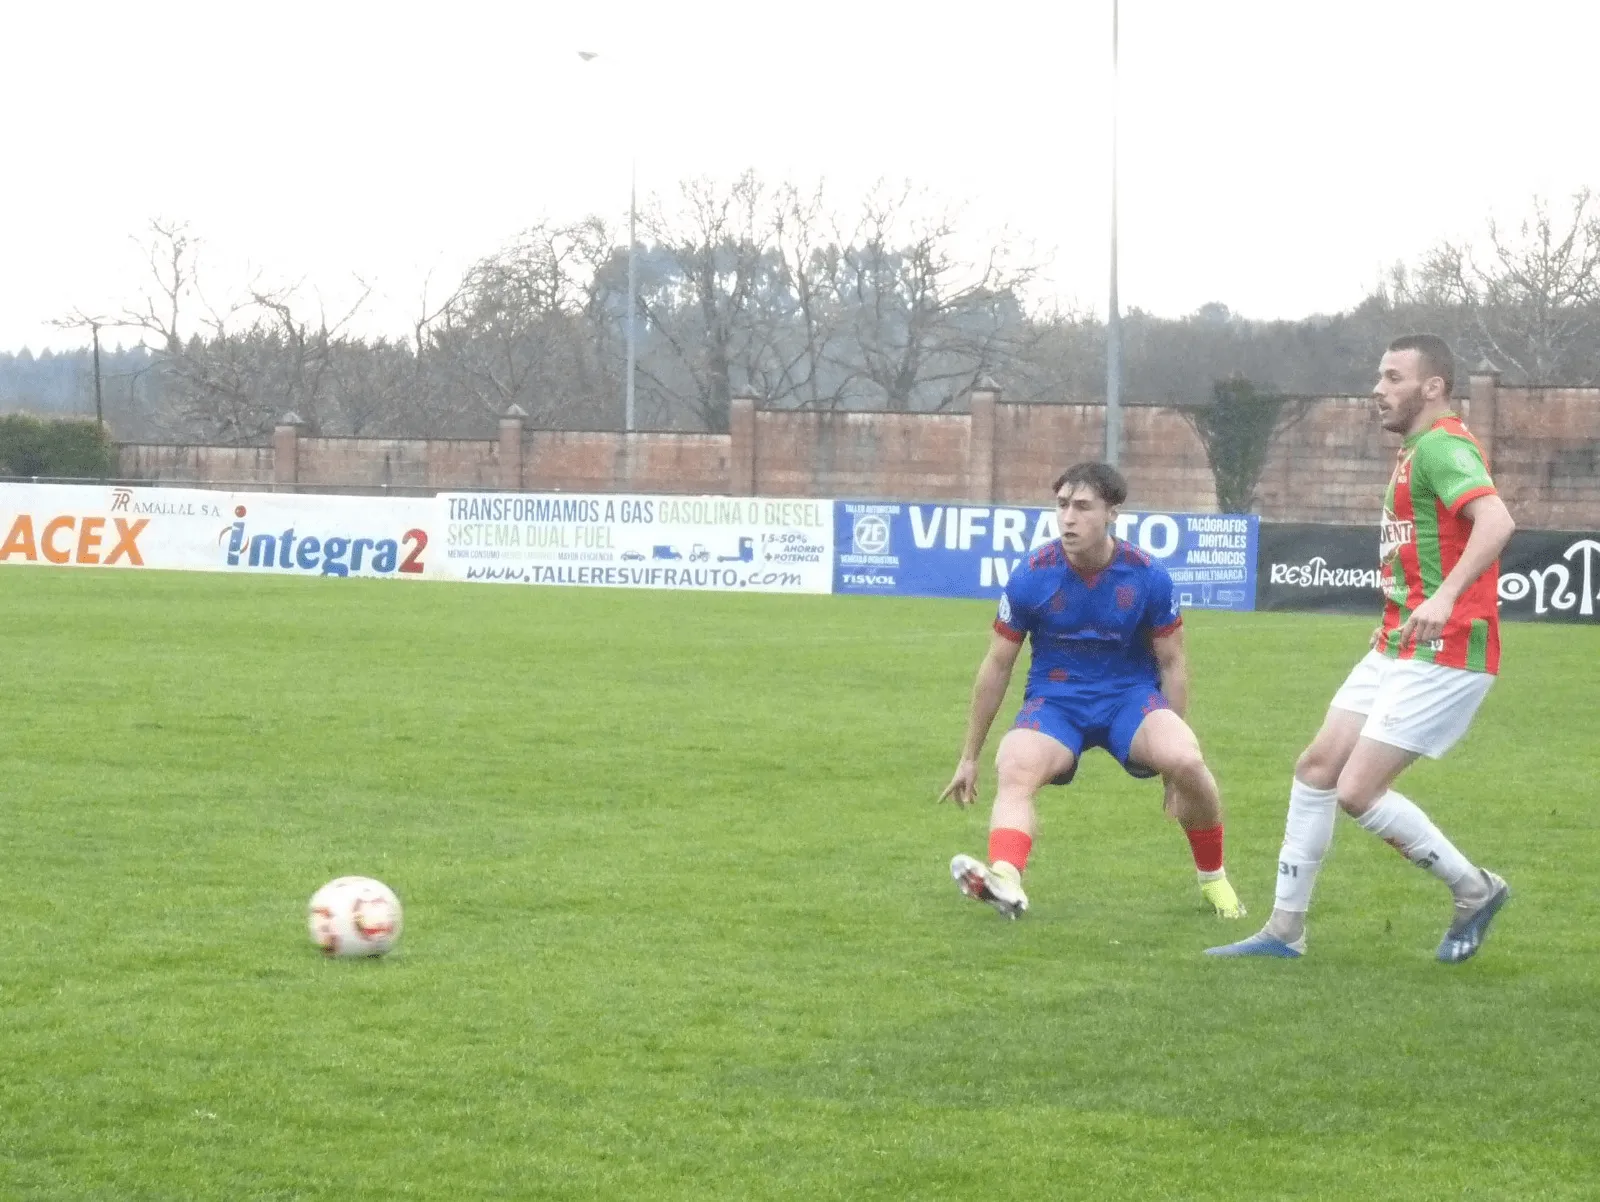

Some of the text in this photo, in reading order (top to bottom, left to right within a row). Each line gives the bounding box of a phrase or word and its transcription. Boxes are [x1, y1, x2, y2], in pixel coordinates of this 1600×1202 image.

[448, 498, 824, 527] TRANSFORMAMOS A GAS GASOLINA O DIESEL
[857, 523, 886, 545] ZF
[908, 505, 1179, 559] VIFRATO
[1187, 516, 1248, 533] TACÓGRAFOS
[0, 514, 150, 566] ACEX
[226, 505, 428, 577] integra2
[447, 523, 616, 549] SISTEMA DUAL FUEL
[1199, 534, 1247, 549] DIGITALES
[783, 545, 825, 554] AHORRO
[1186, 549, 1246, 566] ANALÓGICOS
[1195, 569, 1243, 581] MULTIMARCA
[1279, 861, 1299, 878] 31
